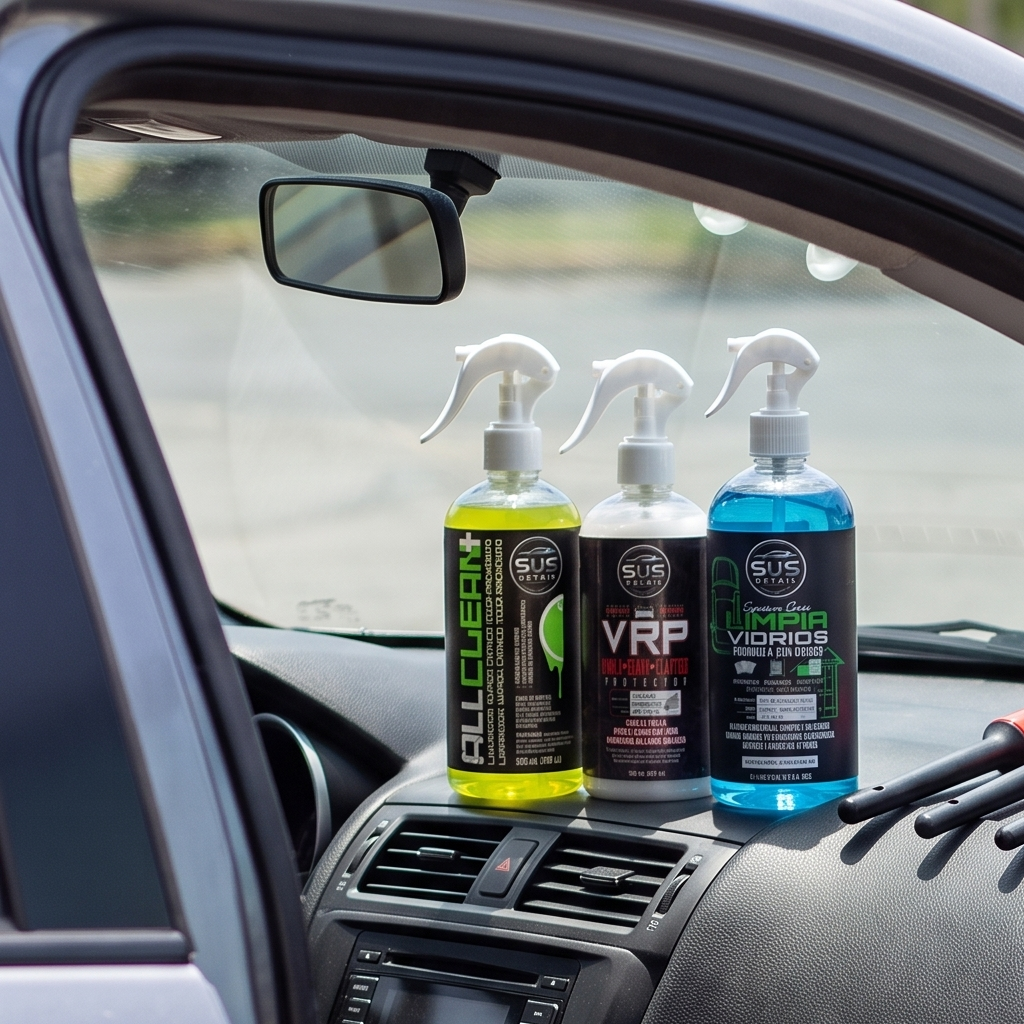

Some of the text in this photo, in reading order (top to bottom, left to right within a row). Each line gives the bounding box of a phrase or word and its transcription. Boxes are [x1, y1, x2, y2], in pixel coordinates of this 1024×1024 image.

[514, 556, 558, 573] SUS
[622, 564, 665, 579] SUS
[750, 560, 801, 577] SUS
[726, 610, 828, 631] LIMPIA
[602, 620, 688, 655] VRP
[727, 630, 829, 646] VIDRIOS
